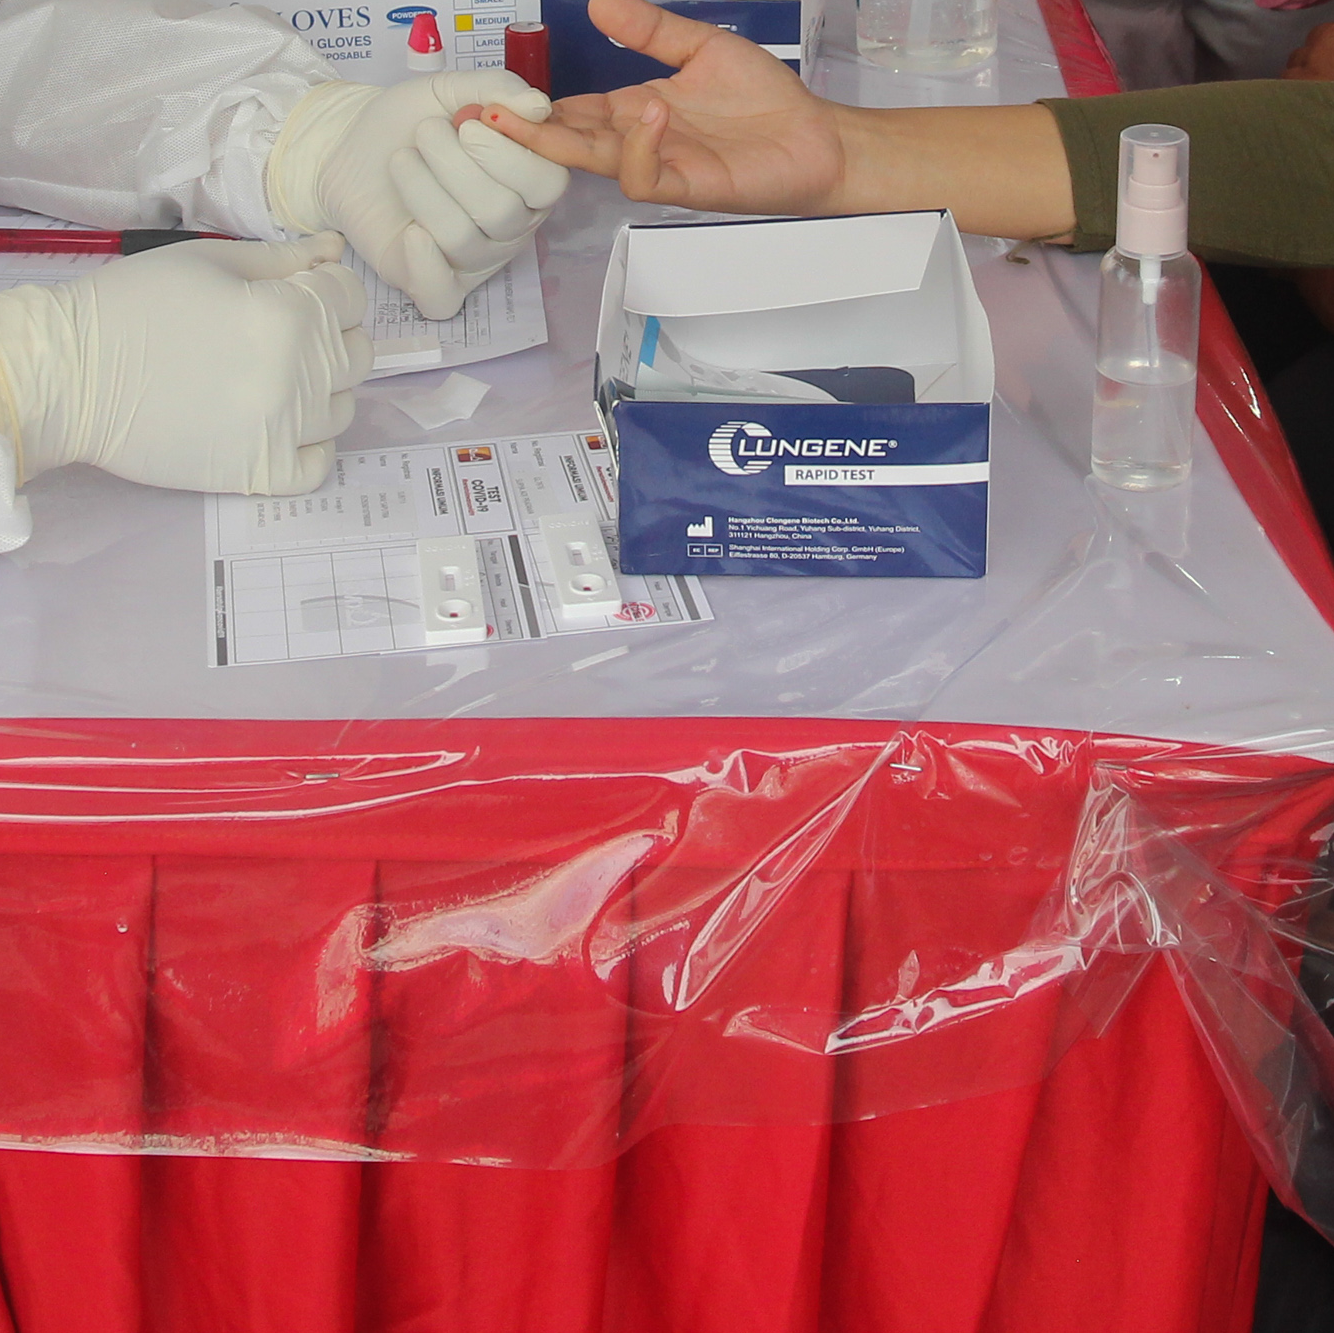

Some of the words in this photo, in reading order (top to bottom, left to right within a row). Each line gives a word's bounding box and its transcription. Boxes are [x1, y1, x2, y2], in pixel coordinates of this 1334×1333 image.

[474, 16, 510, 26] MEDIUM
[317, 35, 372, 49] GLOVES
[477, 59, 505, 68] X-LAR
[563, 455, 582, 485] INFORMASI
[795, 468, 838, 481] RAPID
[841, 468, 875, 481] TEST
[431, 467, 445, 498] INFORMASI
[471, 479, 489, 513] COVID-19
[486, 486, 502, 503] TEST
[436, 497, 449, 516] UMUM
[728, 516, 765, 525] Hangzhou
[766, 517, 801, 525] Clongene
[802, 517, 829, 525] Biotech
[745, 525, 777, 533] Yichuang
[778, 525, 799, 533] Road,
[800, 525, 826, 534] Yuhang
[868, 525, 895, 534] Yuhang
[728, 544, 760, 553] Shanghai
[804, 545, 831, 554] Holding
[831, 545, 851, 554] Corp.
[851, 545, 874, 553] GmbH
[874, 545, 905, 554] (Europe)
[811, 553, 845, 562] Hamburg,
[845, 553, 877, 562] Germany
